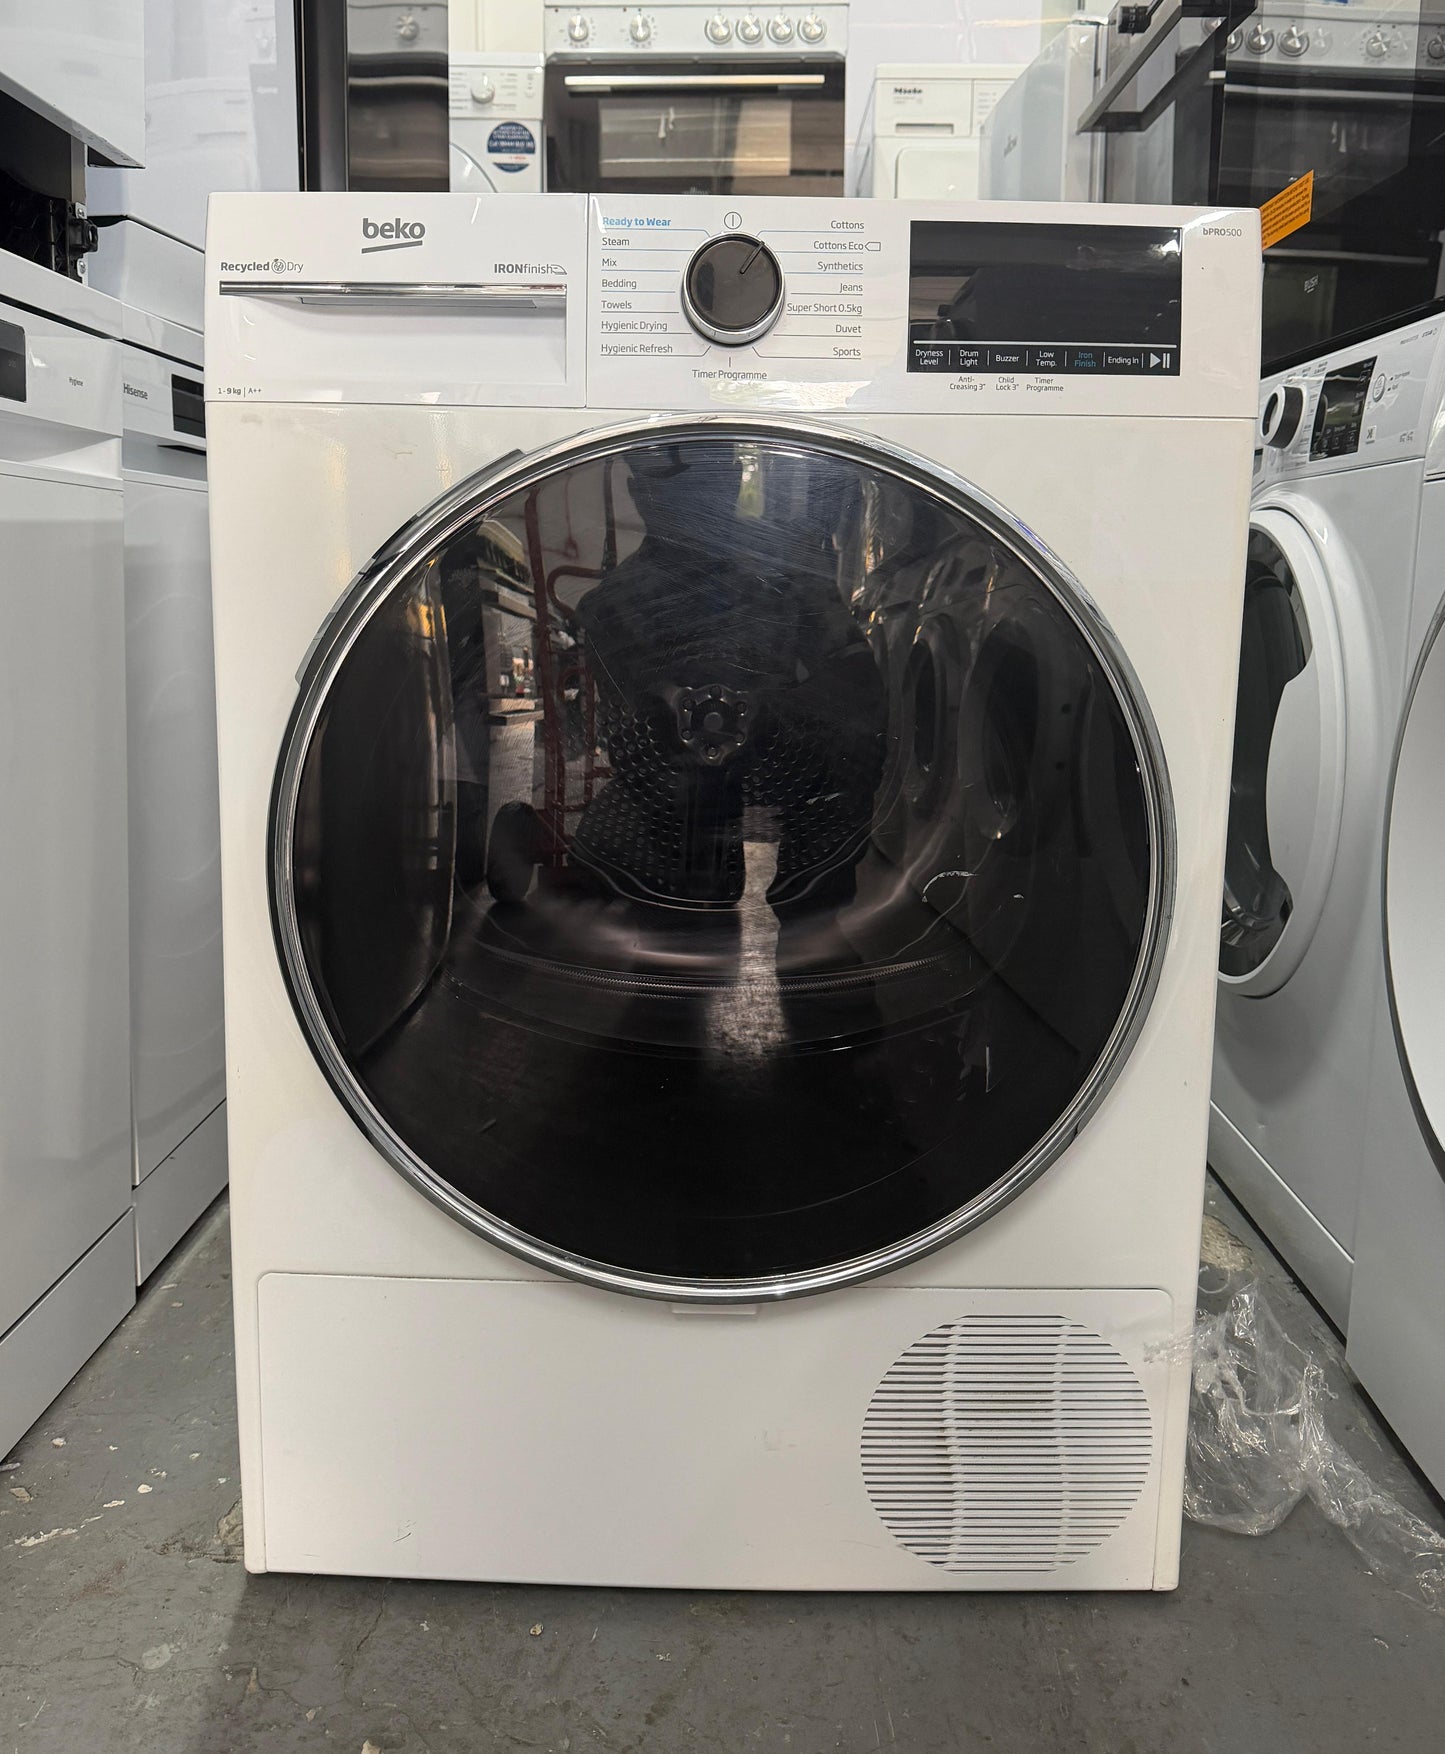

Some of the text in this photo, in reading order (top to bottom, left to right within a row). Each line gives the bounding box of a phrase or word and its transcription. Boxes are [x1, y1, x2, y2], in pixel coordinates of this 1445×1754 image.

[602, 217, 672, 227] Ready to Wear
[830, 220, 864, 230] Cottons
[362, 218, 426, 239] beko
[1202, 228, 1242, 237] bPRO500
[602, 237, 630, 246] Steam
[813, 240, 864, 250] Cottons Eco
[220, 262, 304, 273] Recycled Dry
[602, 258, 617, 267] Mix
[817, 261, 864, 271] Synthetics
[494, 263, 554, 274] IRONfinish
[602, 279, 637, 289] Bedding
[840, 283, 863, 293] Jeans
[601, 300, 633, 309] Towels
[787, 303, 863, 314] Super Short 0.5kg
[601, 320, 668, 332] Hygienic Drying
[835, 324, 862, 333] Duvet
[601, 344, 673, 354] Hygienic Refresh
[833, 347, 861, 357] Sports
[915, 349, 944, 358] Dryness
[960, 358, 978, 367] Light
[995, 355, 1020, 363] Buzzer
[1036, 359, 1057, 367] Temp.
[1074, 359, 1096, 367] Finish
[1108, 356, 1131, 366] Ending
[692, 369, 767, 381] Timer Programme
[123, 383, 149, 400] Hisense
[949, 383, 978, 391] Creasing
